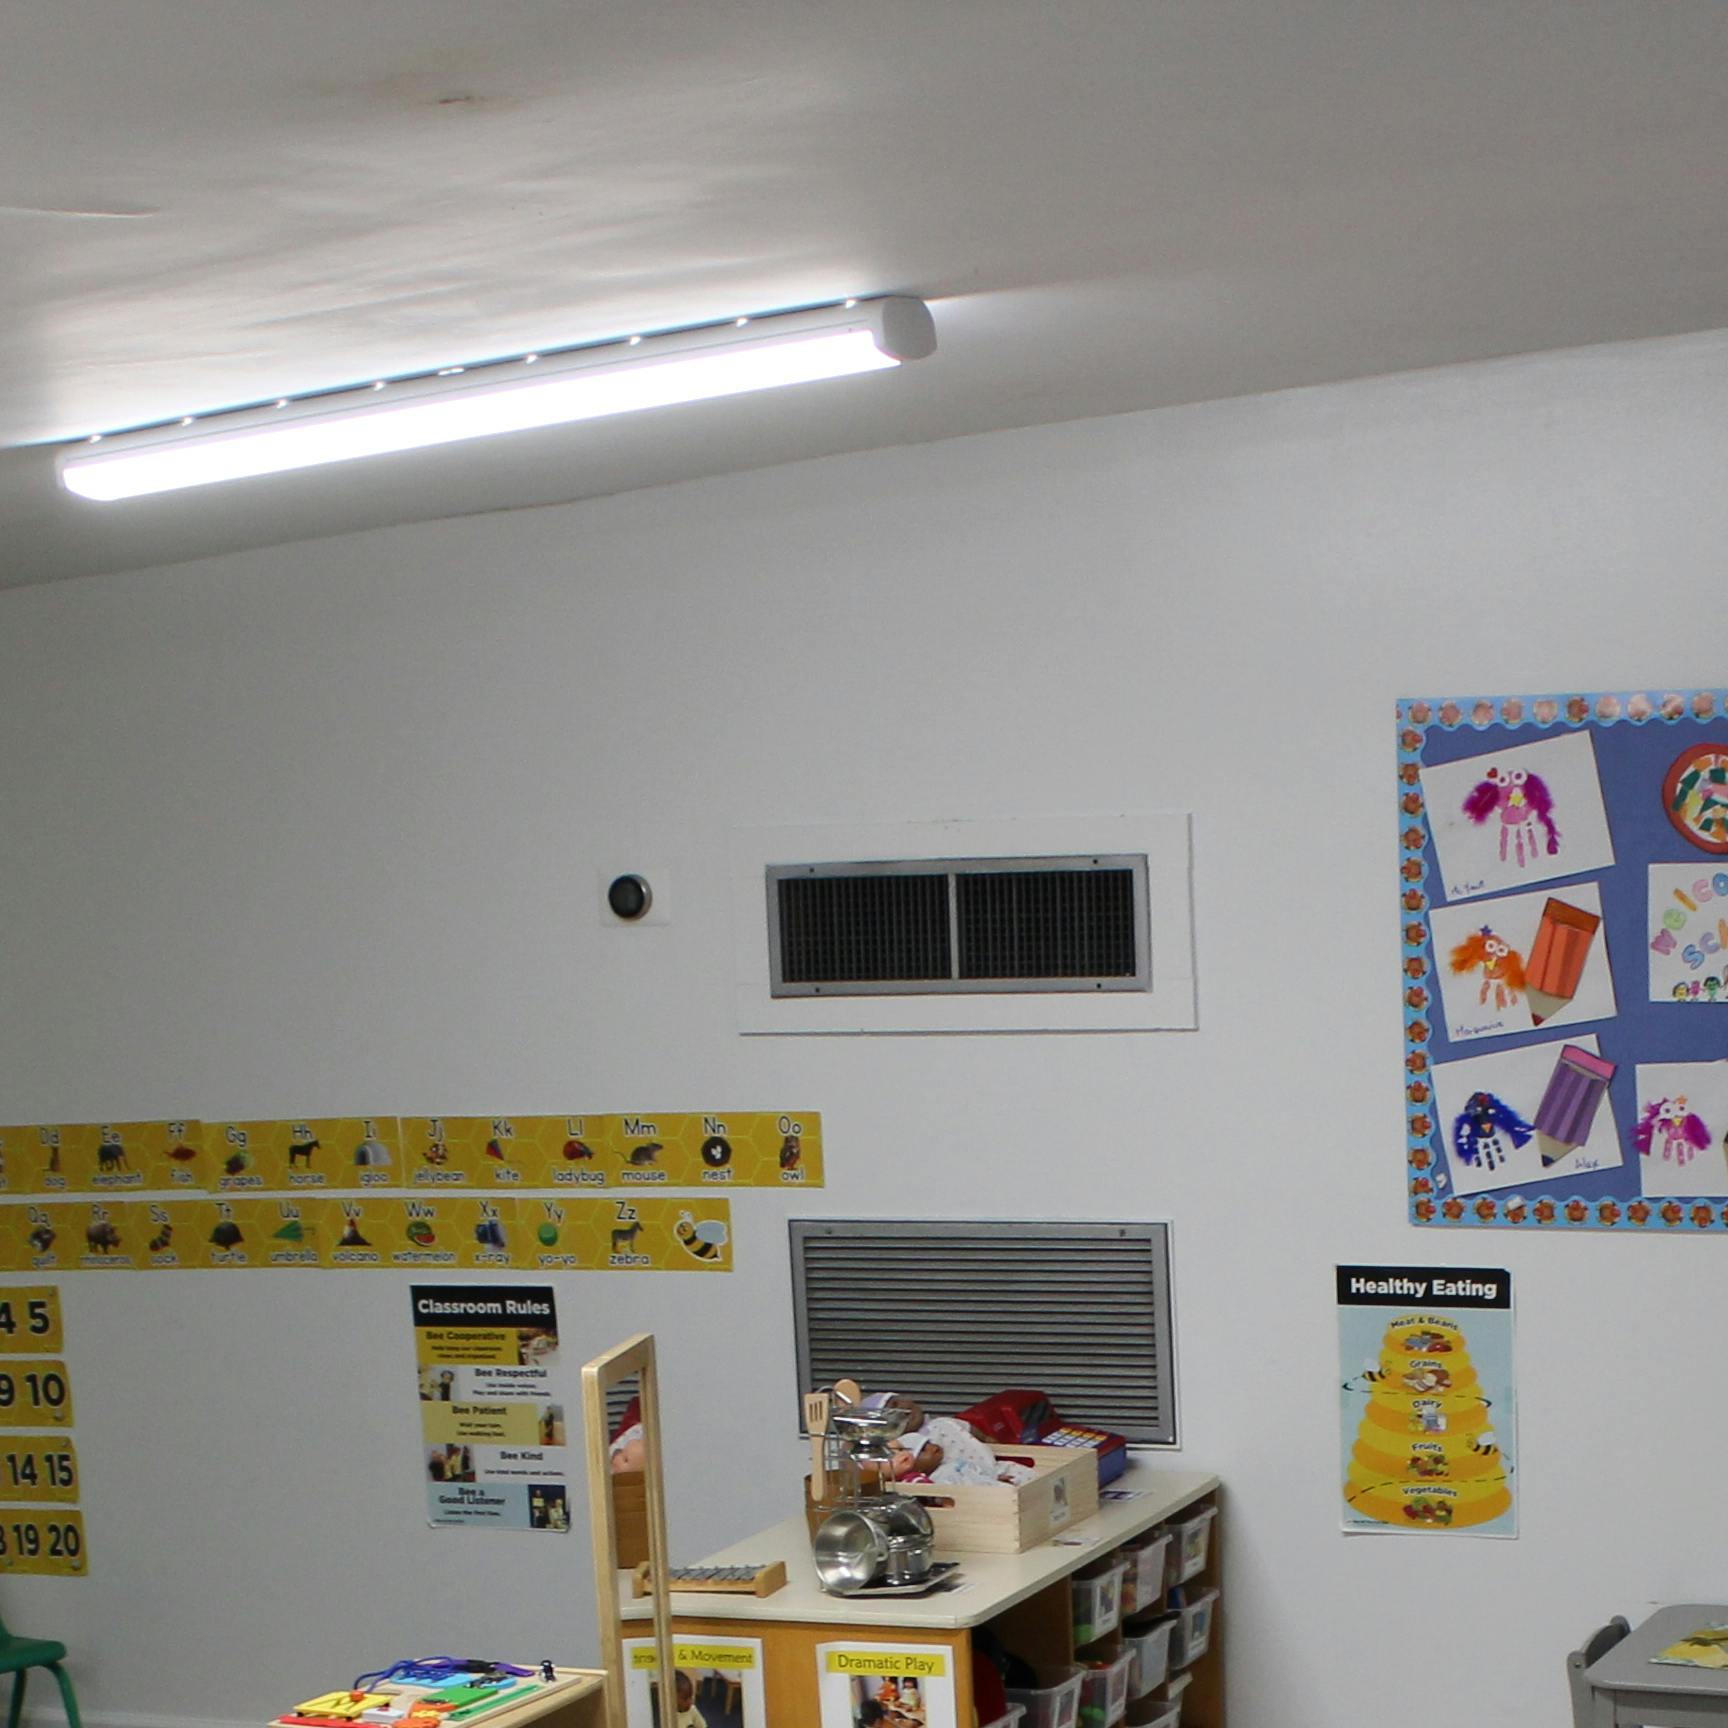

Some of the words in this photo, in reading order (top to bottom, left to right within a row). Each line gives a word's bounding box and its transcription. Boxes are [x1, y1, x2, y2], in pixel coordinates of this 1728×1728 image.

[40, 1128, 59, 1146] Dd
[101, 1126, 120, 1144] Ee
[169, 1123, 186, 1139] Ff
[225, 1126, 249, 1147] Gg
[291, 1124, 312, 1141] Hh
[364, 1120, 376, 1138] Ii
[427, 1120, 444, 1141] Jj
[493, 1119, 513, 1137] Kk
[568, 1118, 583, 1137] Ll
[624, 1118, 655, 1137] Mm
[704, 1116, 726, 1136] Nn
[779, 1115, 801, 1135] Oo
[44, 1176, 66, 1190] dog
[92, 1170, 142, 1186] elephant
[170, 1169, 193, 1183] fish
[219, 1174, 263, 1189] grapes
[289, 1170, 325, 1184] horse
[359, 1170, 388, 1186] igloo
[414, 1168, 465, 1185] jellybean
[495, 1168, 521, 1183] kite
[552, 1167, 605, 1186] ladybug
[622, 1171, 666, 1183] mouse
[702, 1169, 732, 1183] nest
[780, 1167, 805, 1182] owl
[28, 1207, 50, 1227] Qq
[91, 1204, 109, 1222] Rr
[151, 1205, 170, 1223] Ss
[216, 1202, 232, 1220] Tt
[281, 1202, 300, 1219] Uu
[343, 1202, 362, 1218] Vv
[406, 1201, 435, 1218] Ww
[480, 1201, 499, 1218] Xx
[544, 1201, 564, 1222] Yy
[615, 1201, 637, 1220] Zz
[31, 1253, 57, 1268] quilt
[152, 1251, 177, 1264] sock
[211, 1250, 247, 1263] turtle
[271, 1249, 318, 1263] umbrella
[332, 1251, 378, 1263] volcano
[393, 1250, 456, 1264] watermelon
[475, 1252, 511, 1266] x-ray
[538, 1253, 577, 1266] yo-yo
[610, 1253, 650, 1266] zebra
[1350, 1277, 1427, 1298] Healthy
[1432, 1279, 1498, 1299] Eating
[417, 1299, 502, 1314] Classroom
[506, 1300, 551, 1315] Rules
[28, 1301, 50, 1334] 5
[1391, 1317, 1416, 1329] Meat
[1427, 1317, 1459, 1331] Beans
[425, 1331, 444, 1341] Bee
[446, 1331, 506, 1342] Cooperative
[1409, 1360, 1443, 1370] Grains
[475, 1368, 494, 1378] Bee
[495, 1369, 548, 1379] Respectful
[25, 1373, 66, 1407] 10
[452, 1406, 470, 1415] Bee
[473, 1406, 507, 1416] Patient
[1412, 1399, 1442, 1410] Dairy
[500, 1451, 518, 1461] Bee
[520, 1451, 544, 1461] Kind
[1412, 1443, 1442, 1453] Fruits
[6, 1454, 38, 1486] 14
[45, 1454, 74, 1486] 15
[458, 1487, 477, 1497] Bee
[1402, 1486, 1458, 1498] Vegetables
[438, 1495, 466, 1505] Good
[467, 1496, 506, 1506] Listener
[13, 1523, 40, 1556] 19
[48, 1523, 81, 1557] 20
[678, 1648, 688, 1661] &
[691, 1649, 753, 1665] Movement
[836, 1654, 901, 1670] Dramatic
[904, 1656, 935, 1674] Play
